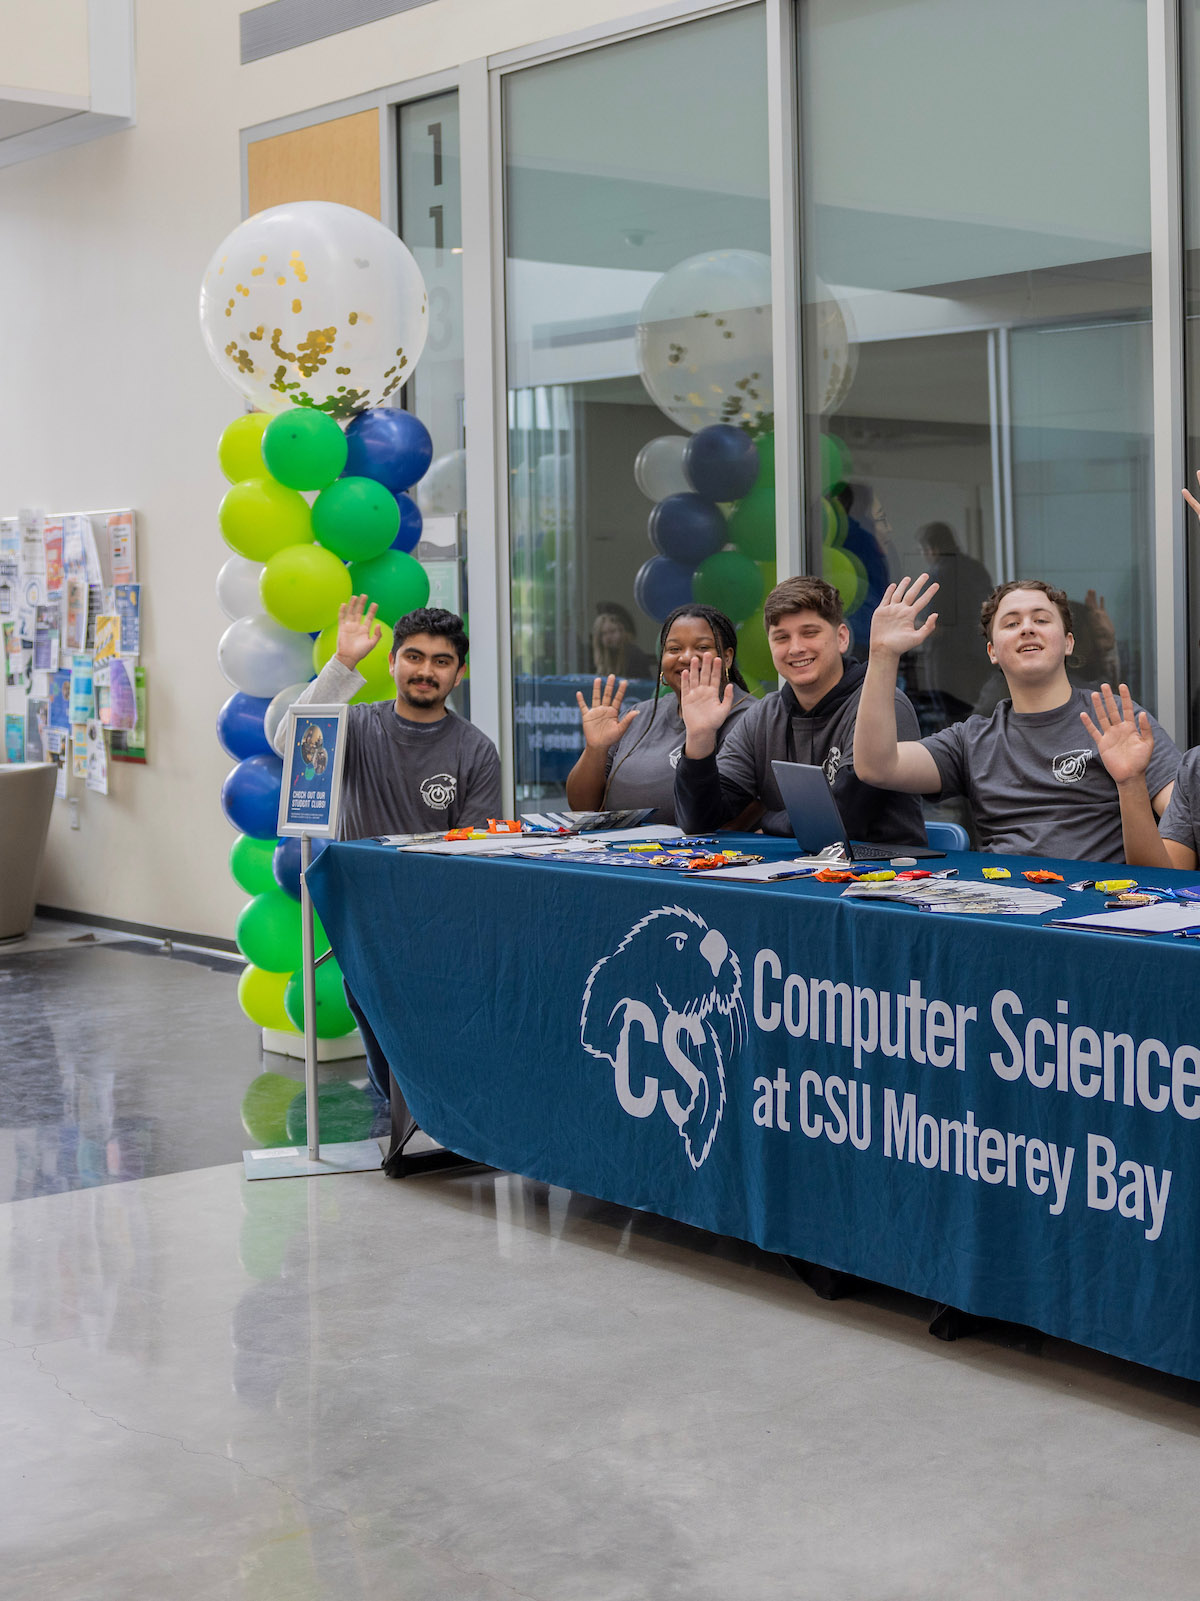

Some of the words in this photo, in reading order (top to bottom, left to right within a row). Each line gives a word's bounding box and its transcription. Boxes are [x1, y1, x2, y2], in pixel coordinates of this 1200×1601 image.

[292, 799, 311, 808] STUDENT
[293, 790, 307, 799] CHECK
[307, 791, 316, 799] OUT
[316, 791, 325, 800] OUR
[614, 1000, 707, 1129] CS
[753, 948, 978, 1071] Computer
[752, 1067, 791, 1132] at
[799, 1069, 872, 1151] CSU
[883, 1087, 1075, 1215] Monterey
[1087, 1133, 1173, 1241] Bay
